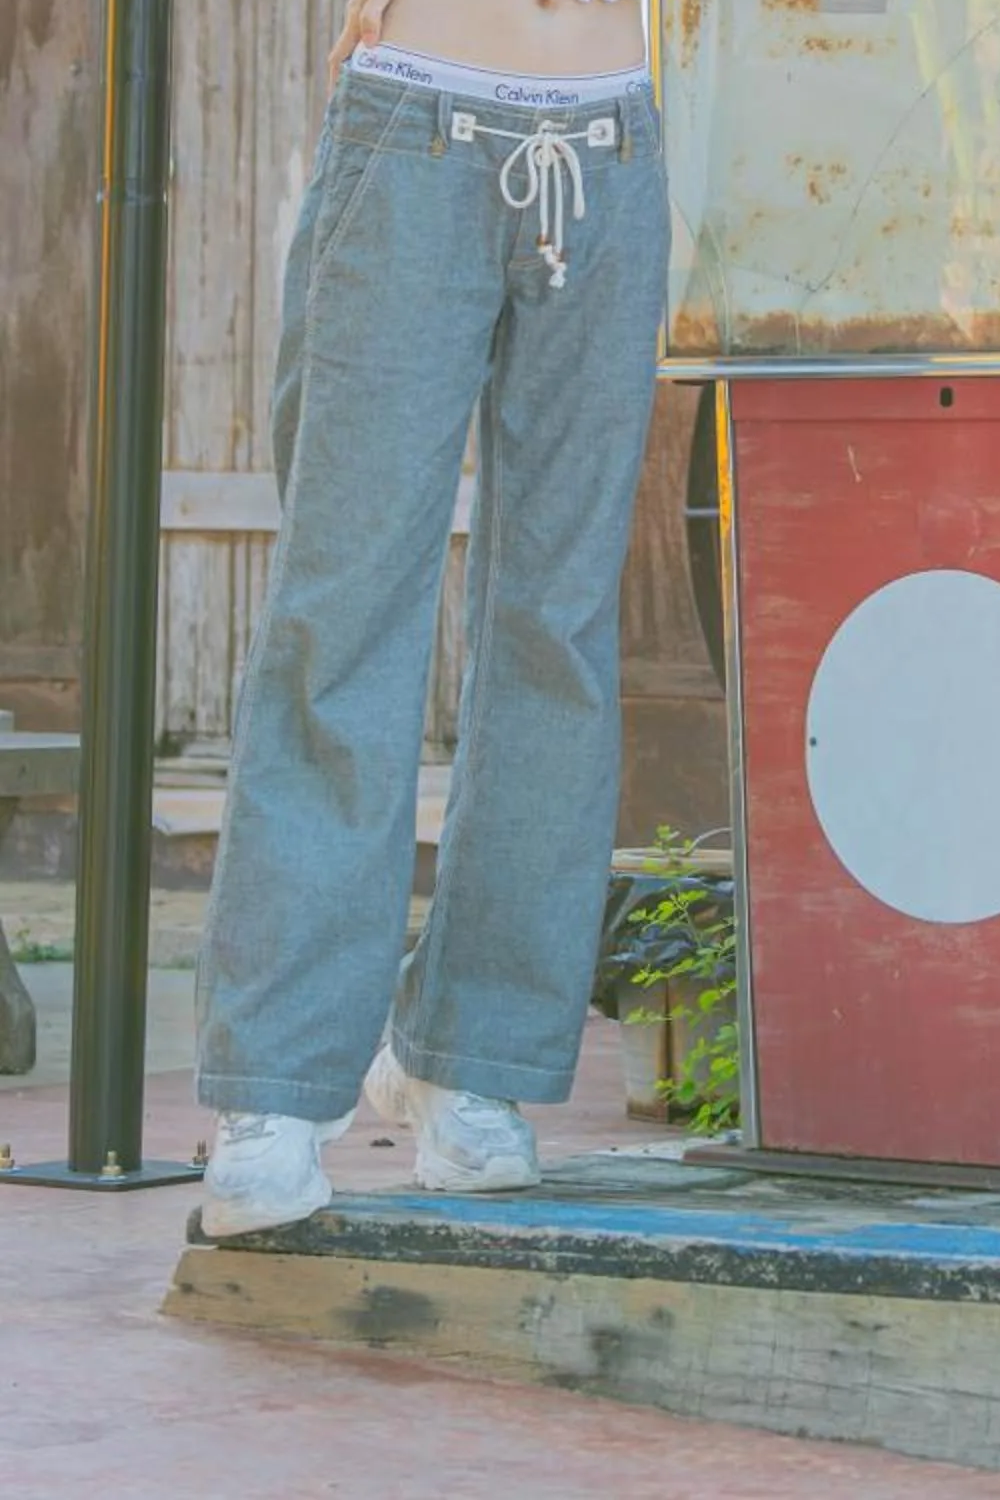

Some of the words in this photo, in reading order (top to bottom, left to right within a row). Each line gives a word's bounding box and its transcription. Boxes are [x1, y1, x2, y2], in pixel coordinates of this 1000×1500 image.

[356, 51, 393, 73] Calvin
[395, 62, 433, 85] Klein
[495, 84, 543, 104] Calvin
[544, 88, 579, 105] Klein
